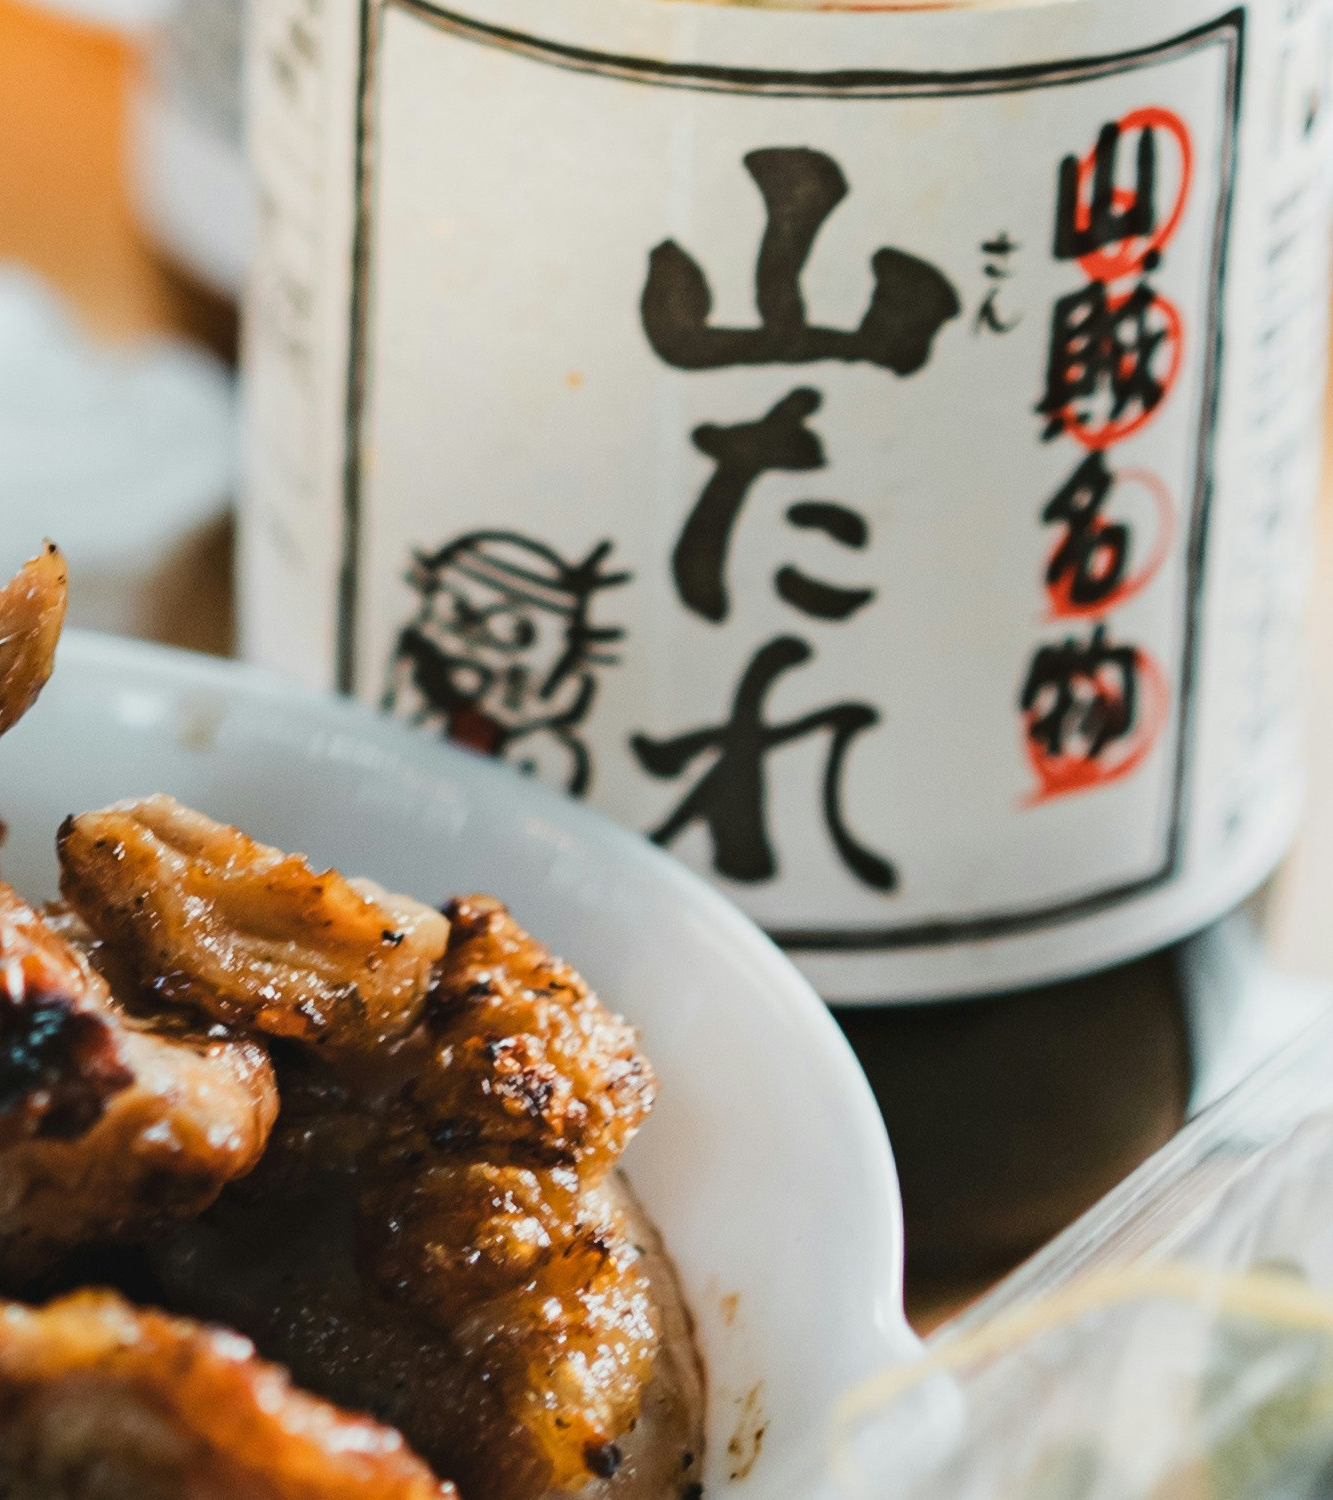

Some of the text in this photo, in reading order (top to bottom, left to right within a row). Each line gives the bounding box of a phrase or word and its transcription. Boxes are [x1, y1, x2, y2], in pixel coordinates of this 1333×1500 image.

[973, 230, 1025, 338] さん
[631, 147, 962, 893] 山たれ
